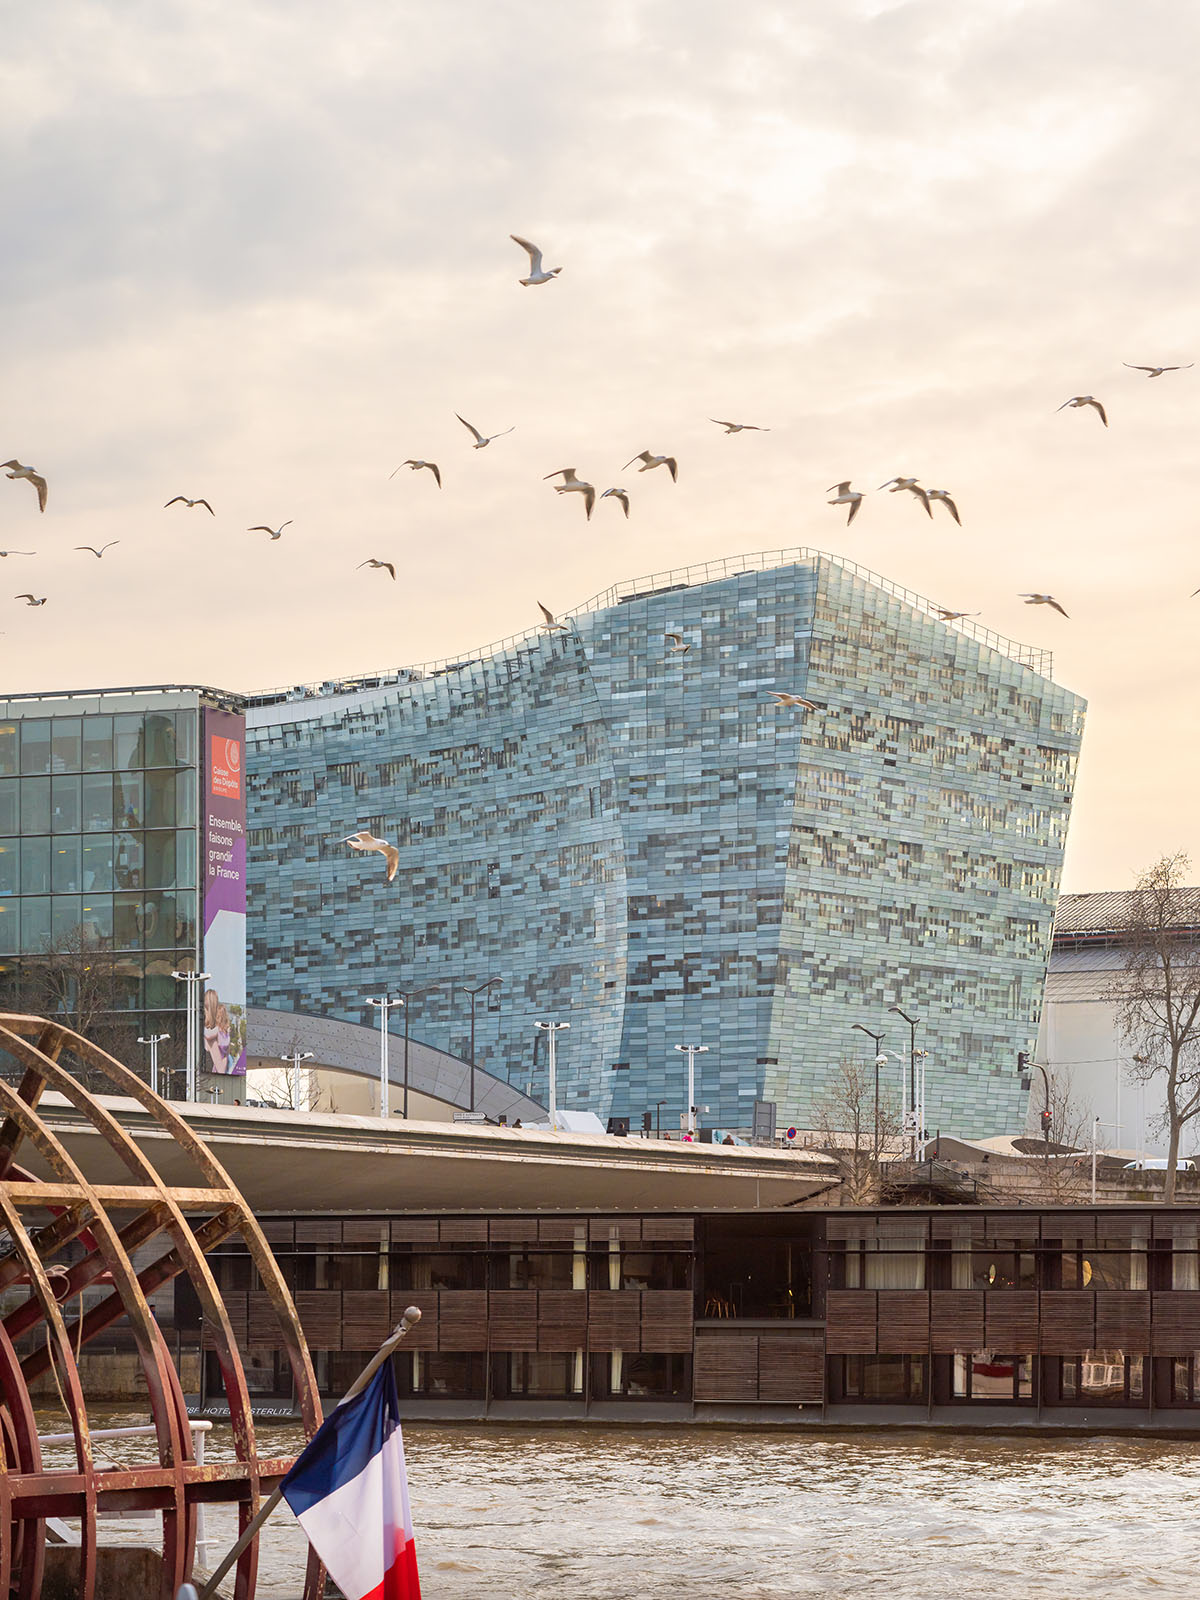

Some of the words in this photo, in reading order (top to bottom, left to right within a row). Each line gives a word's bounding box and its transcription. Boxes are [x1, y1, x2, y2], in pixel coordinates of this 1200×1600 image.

[209, 814, 243, 834] Ensemble,
[209, 831, 233, 846] faisons
[209, 850, 233, 862] grandir
[209, 864, 215, 876] la
[217, 865, 240, 880] France
[250, 1407, 293, 1415] STERLITZ
